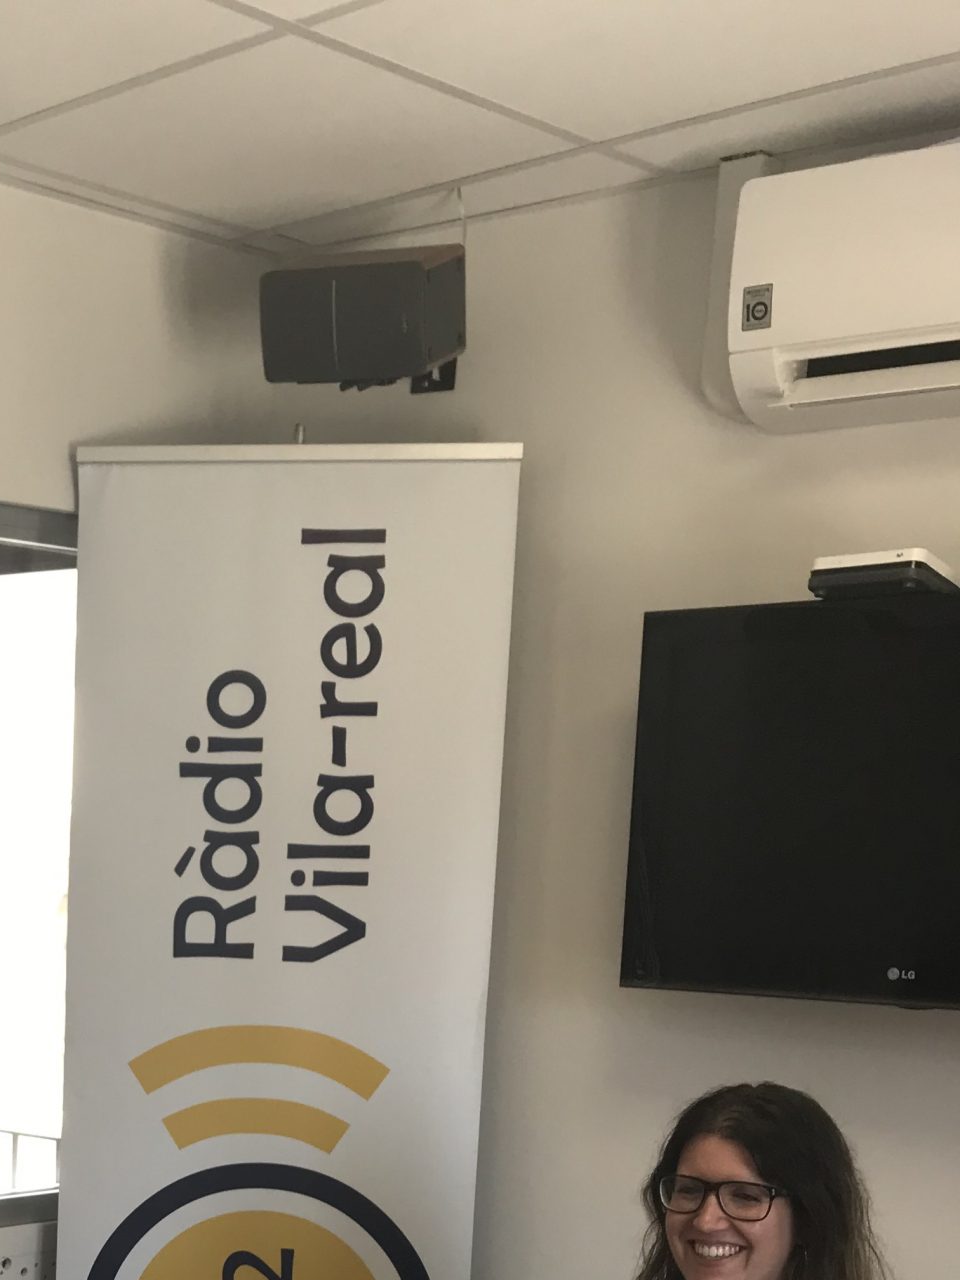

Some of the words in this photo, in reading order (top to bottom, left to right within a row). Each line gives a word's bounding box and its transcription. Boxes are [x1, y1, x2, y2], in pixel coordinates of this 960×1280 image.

[173, 669, 267, 959] Ràdio
[282, 528, 387, 963] Vila-real
[901, 970, 916, 979] LG
